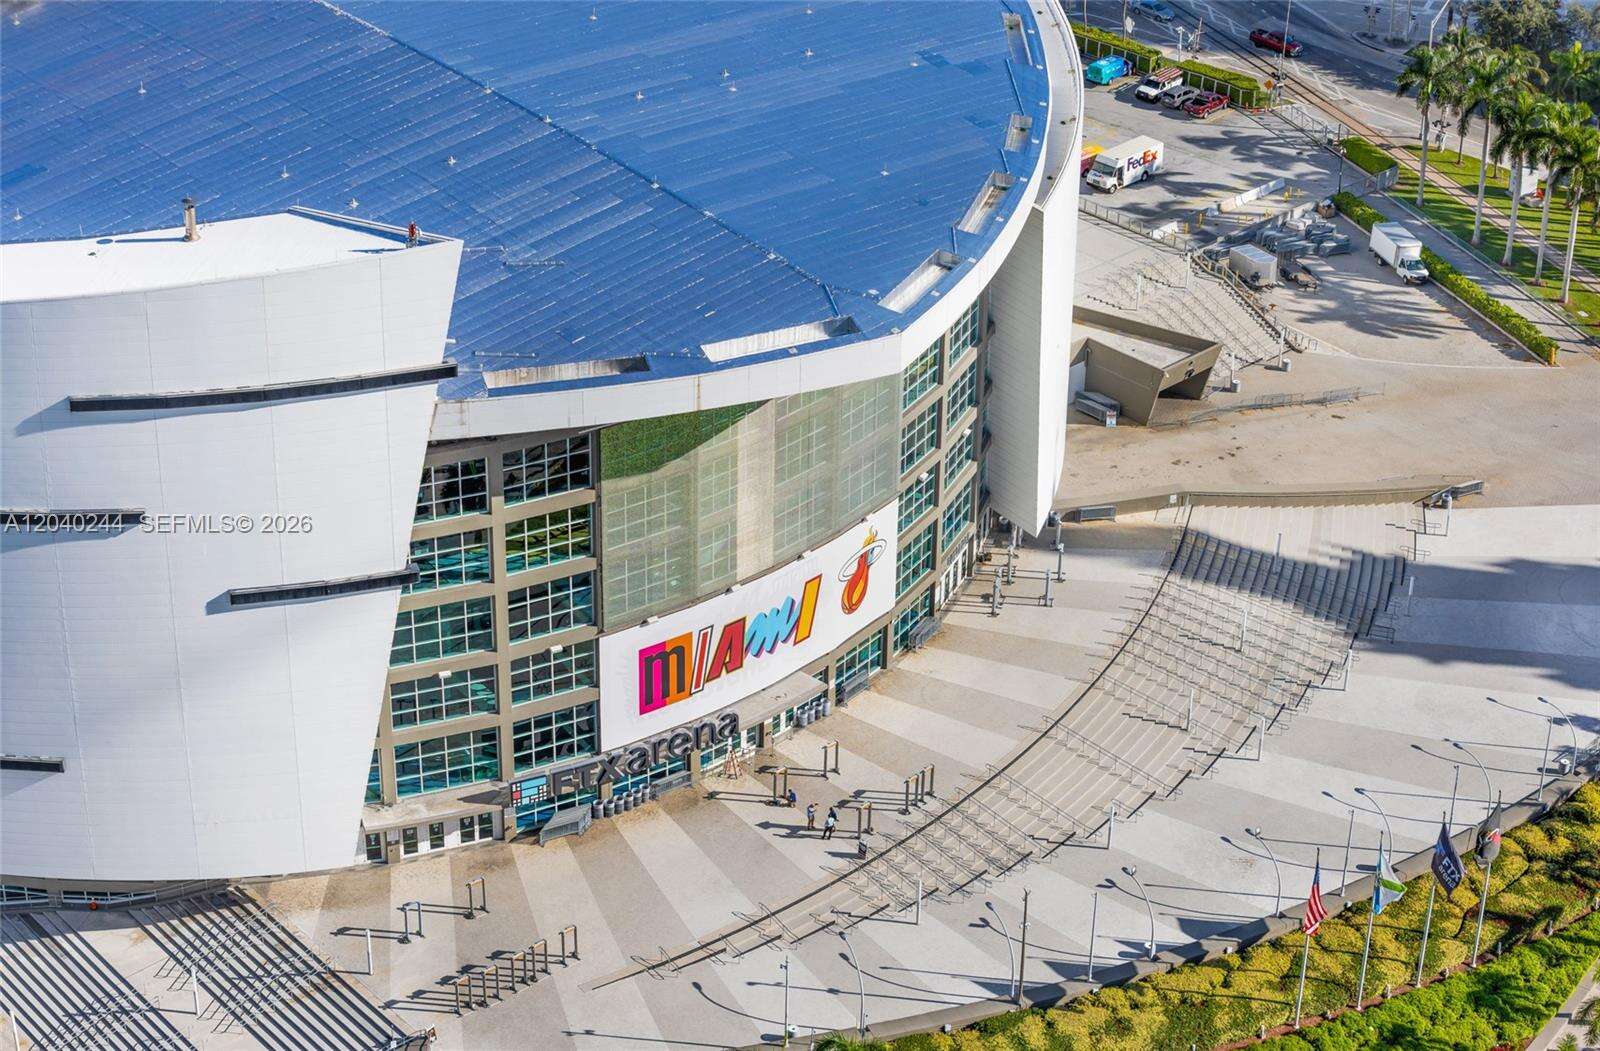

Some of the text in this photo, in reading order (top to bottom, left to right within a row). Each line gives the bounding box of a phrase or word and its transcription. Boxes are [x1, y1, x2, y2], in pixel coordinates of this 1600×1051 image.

[1127, 149, 1158, 172] FedEx
[1438, 865, 1457, 888] arena
[1442, 856, 1460, 881] FTX
